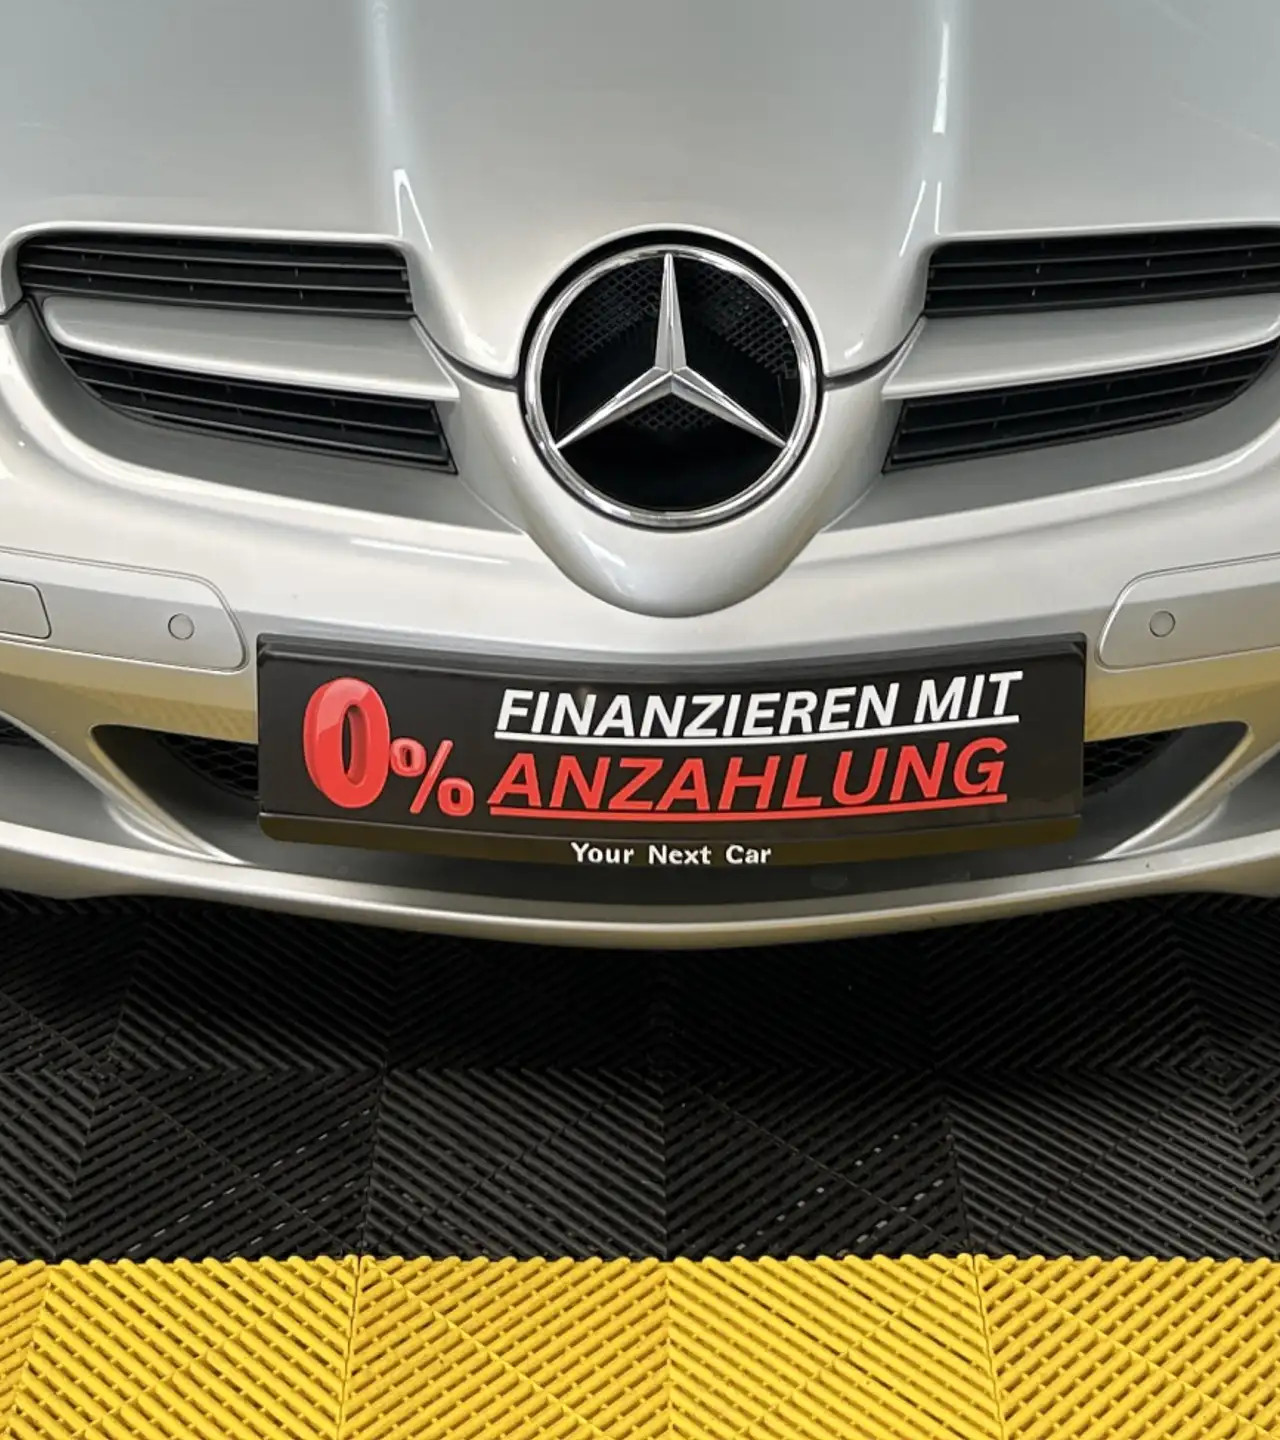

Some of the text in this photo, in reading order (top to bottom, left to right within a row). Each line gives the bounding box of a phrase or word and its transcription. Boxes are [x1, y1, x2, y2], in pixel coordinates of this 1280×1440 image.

[497, 671, 1024, 737] FINANZIEREN MIT
[303, 676, 475, 817] 0%
[489, 738, 1007, 811] ANZAHLUNG
[570, 842, 771, 866] Your Next Car
